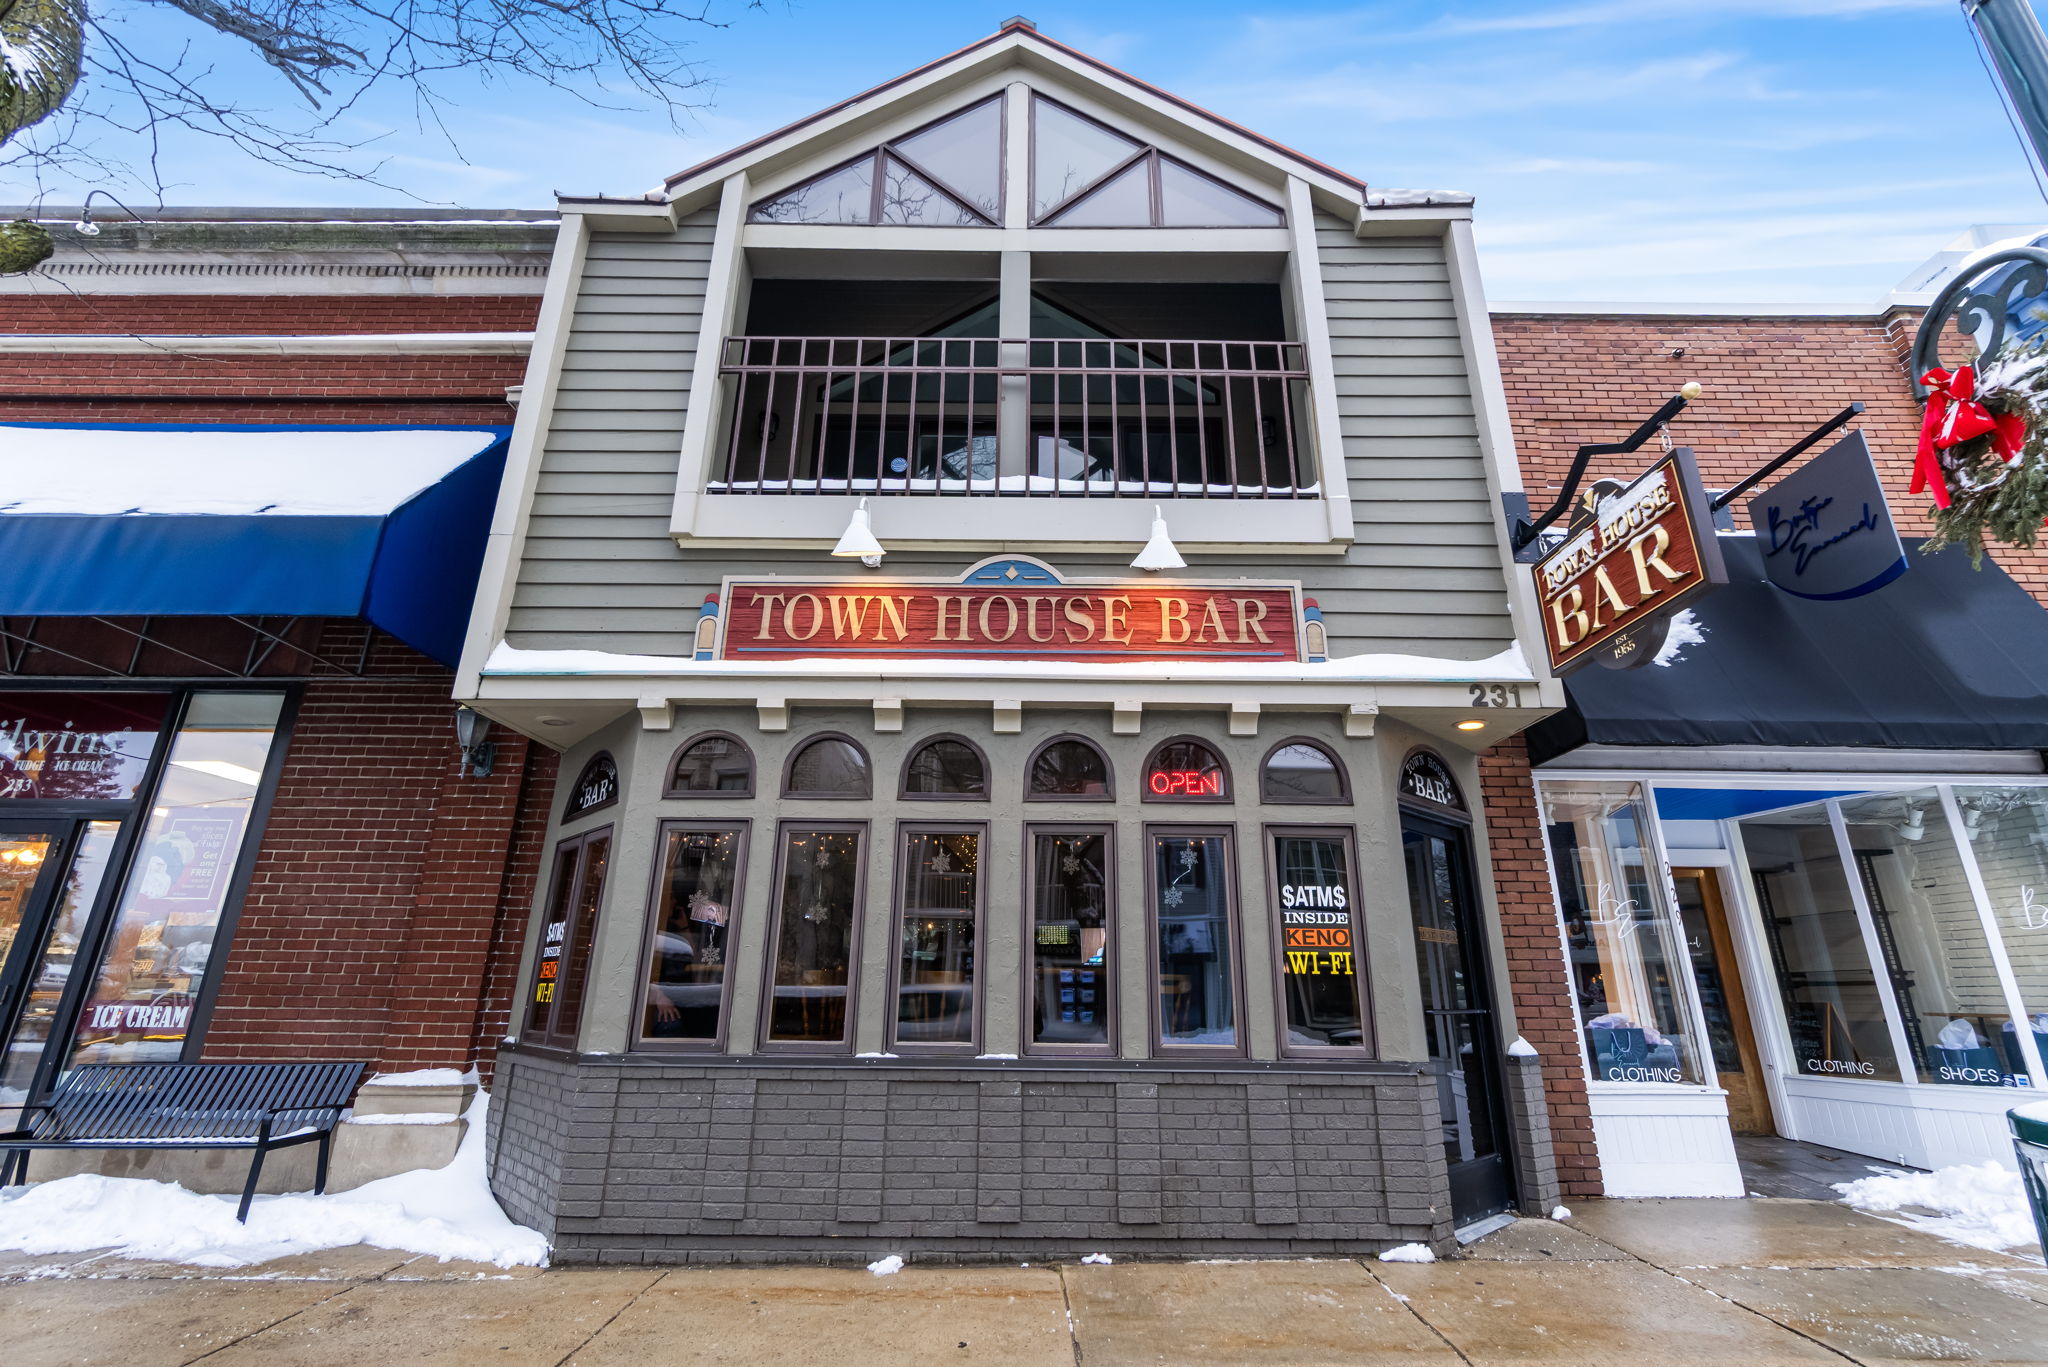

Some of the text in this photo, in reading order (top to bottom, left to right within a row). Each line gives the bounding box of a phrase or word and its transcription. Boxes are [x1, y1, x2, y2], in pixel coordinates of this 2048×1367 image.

[1542, 484, 1671, 593] TOWN HOUSE
[1547, 525, 1692, 653] BAR
[750, 592, 1275, 646] TOWN HOUSE BAR
[1614, 640, 1636, 659] 1955
[1469, 684, 1521, 708] 231
[13, 760, 46, 771] FUDGE
[53, 760, 71, 772] ICE
[71, 760, 104, 772] CREAM
[1405, 754, 1451, 789] TOWN HOUSE
[1150, 771, 1219, 795] OPEN
[1413, 773, 1448, 805] BAR
[582, 779, 609, 809] BAR
[203, 851, 218, 860] Get
[190, 868, 213, 877] FREE
[1282, 884, 1346, 910] $ATM$
[1284, 912, 1349, 924] INSIDE
[1286, 929, 1349, 946] KENO
[543, 945, 561, 958] INSIDE
[540, 962, 558, 978] KENO
[1287, 951, 1353, 975] WI-FI
[536, 983, 555, 1003] WI-FI
[90, 1005, 190, 1028] ICE CREAM
[1608, 1067, 1682, 1082] CLOTHING
[1808, 1058, 1875, 1075] CLOTHING
[1940, 1066, 2000, 1083] SHOES
